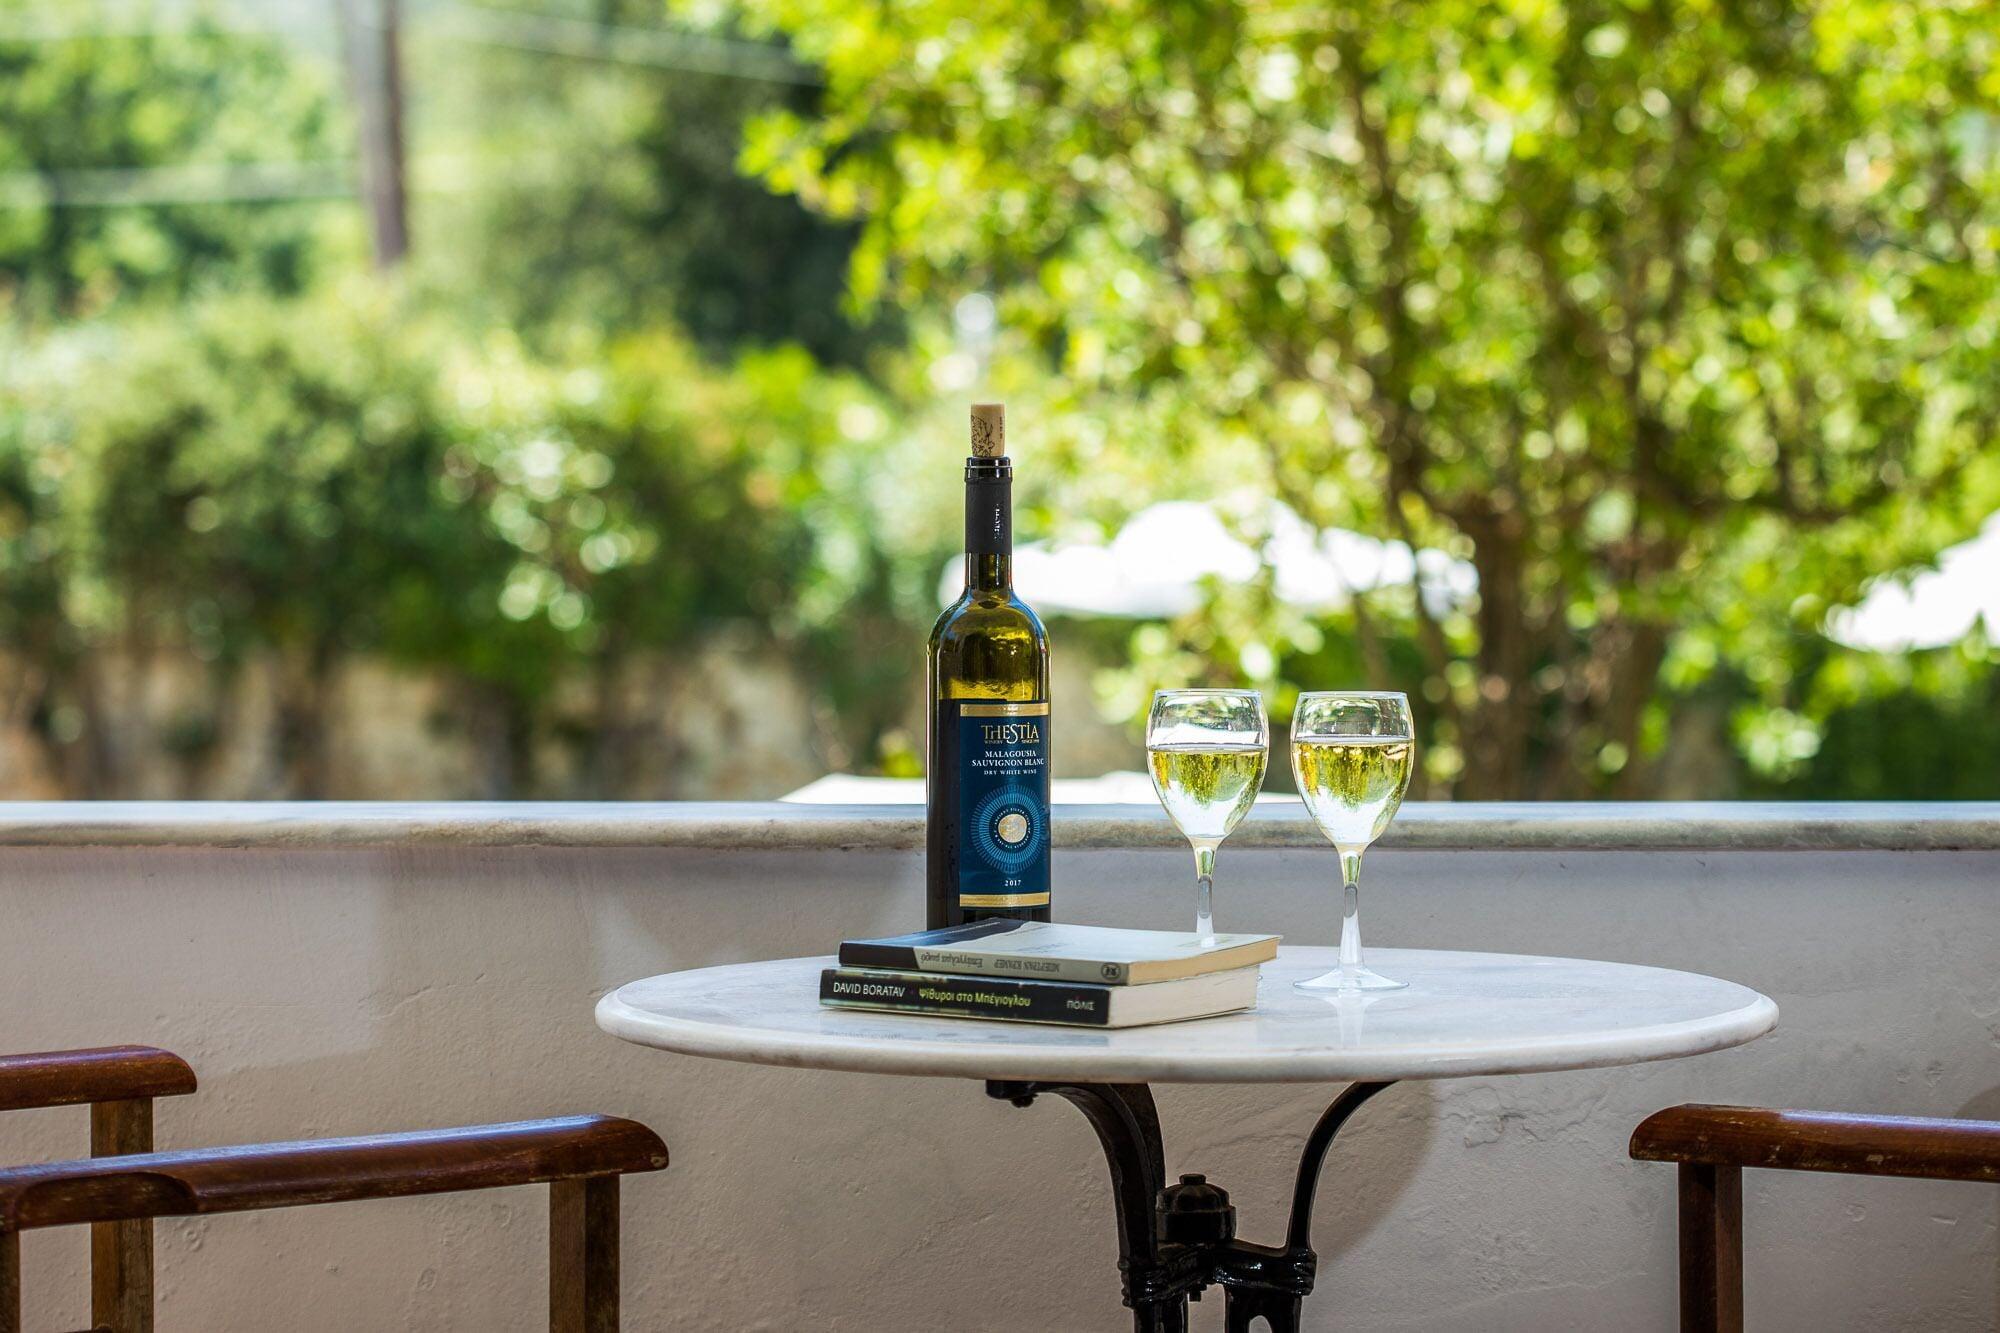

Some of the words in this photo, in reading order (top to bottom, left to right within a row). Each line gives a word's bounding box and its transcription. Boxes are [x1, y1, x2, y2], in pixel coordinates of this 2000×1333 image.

[985, 750, 1036, 758] MALAGOUSIA
[972, 759, 1023, 767] SAUVIGNON
[1024, 758, 1044, 766] BLANC
[833, 982, 861, 994] DAVID
[863, 984, 906, 998] BORATAV
[956, 994, 973, 1002] στο
